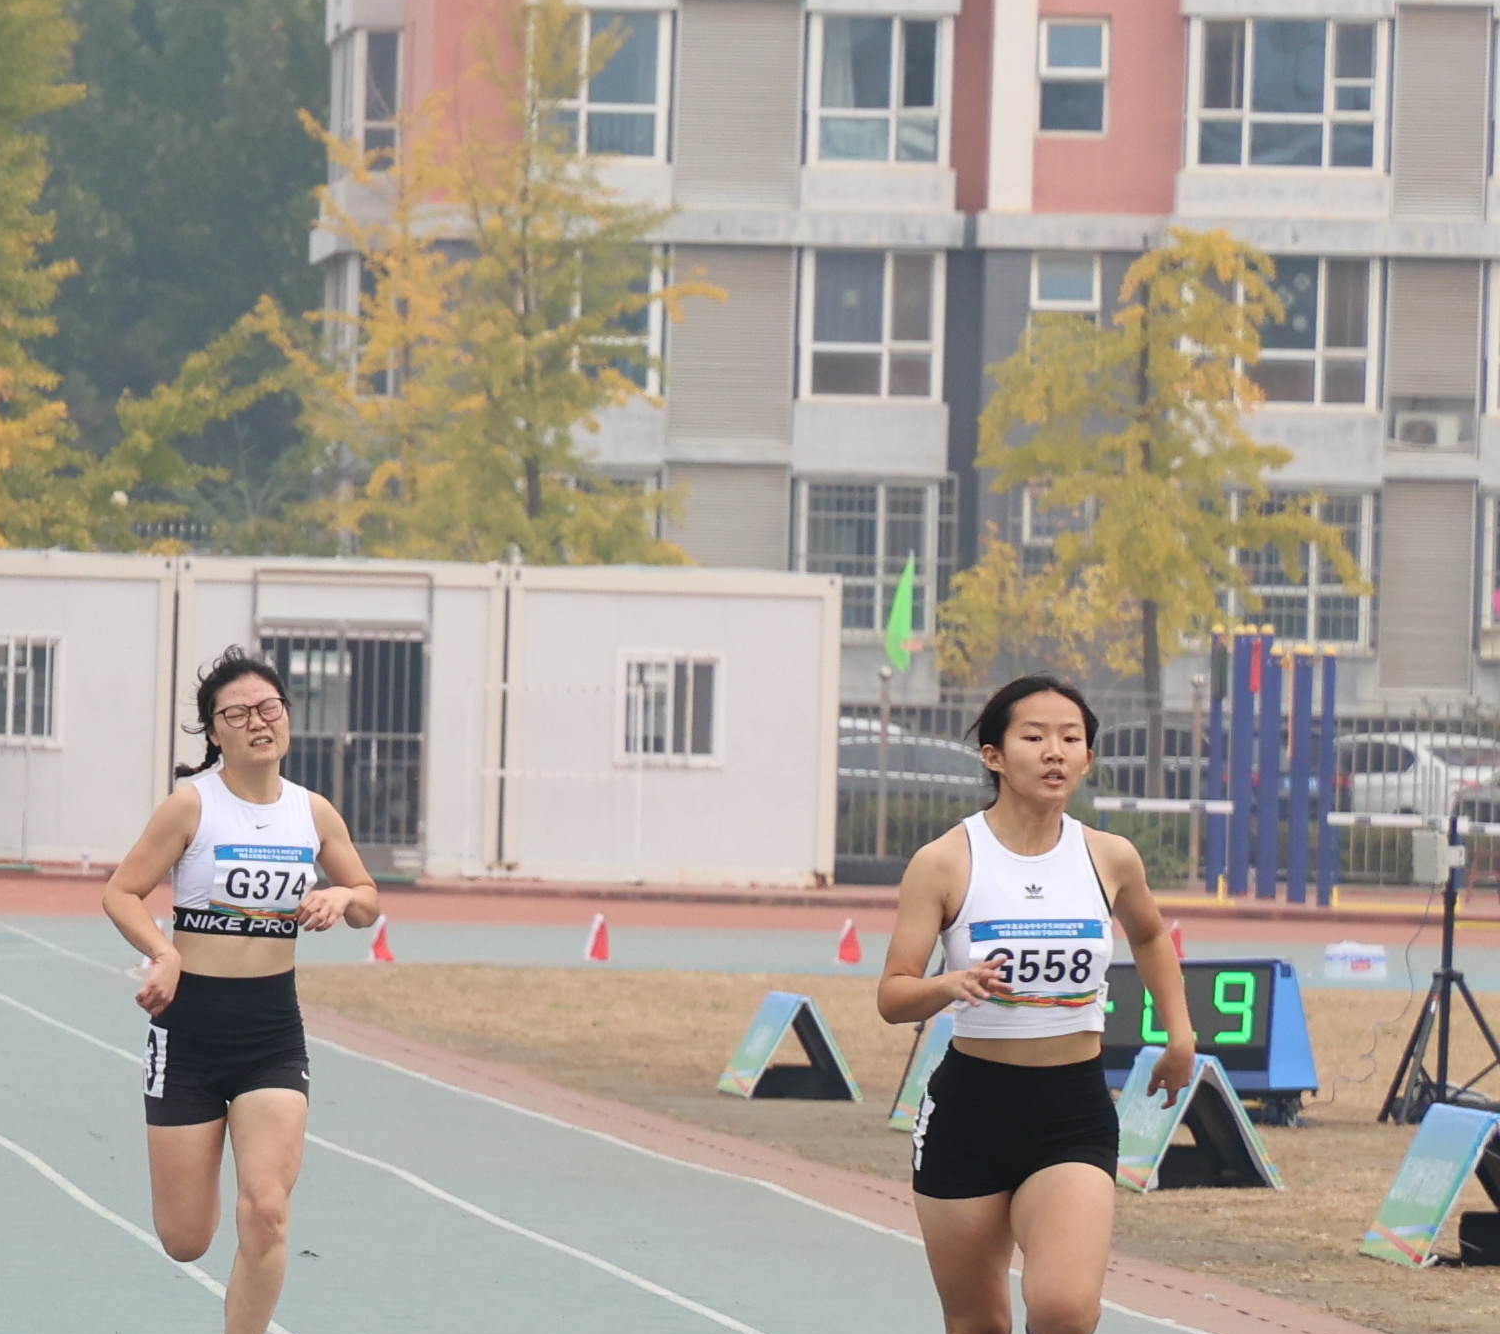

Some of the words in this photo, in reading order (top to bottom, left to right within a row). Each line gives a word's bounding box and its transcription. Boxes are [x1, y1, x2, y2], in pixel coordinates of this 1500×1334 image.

[225, 867, 307, 901] G374
[183, 913, 242, 932] NIKE
[248, 918, 295, 934] PRO
[984, 947, 1093, 984] G558
